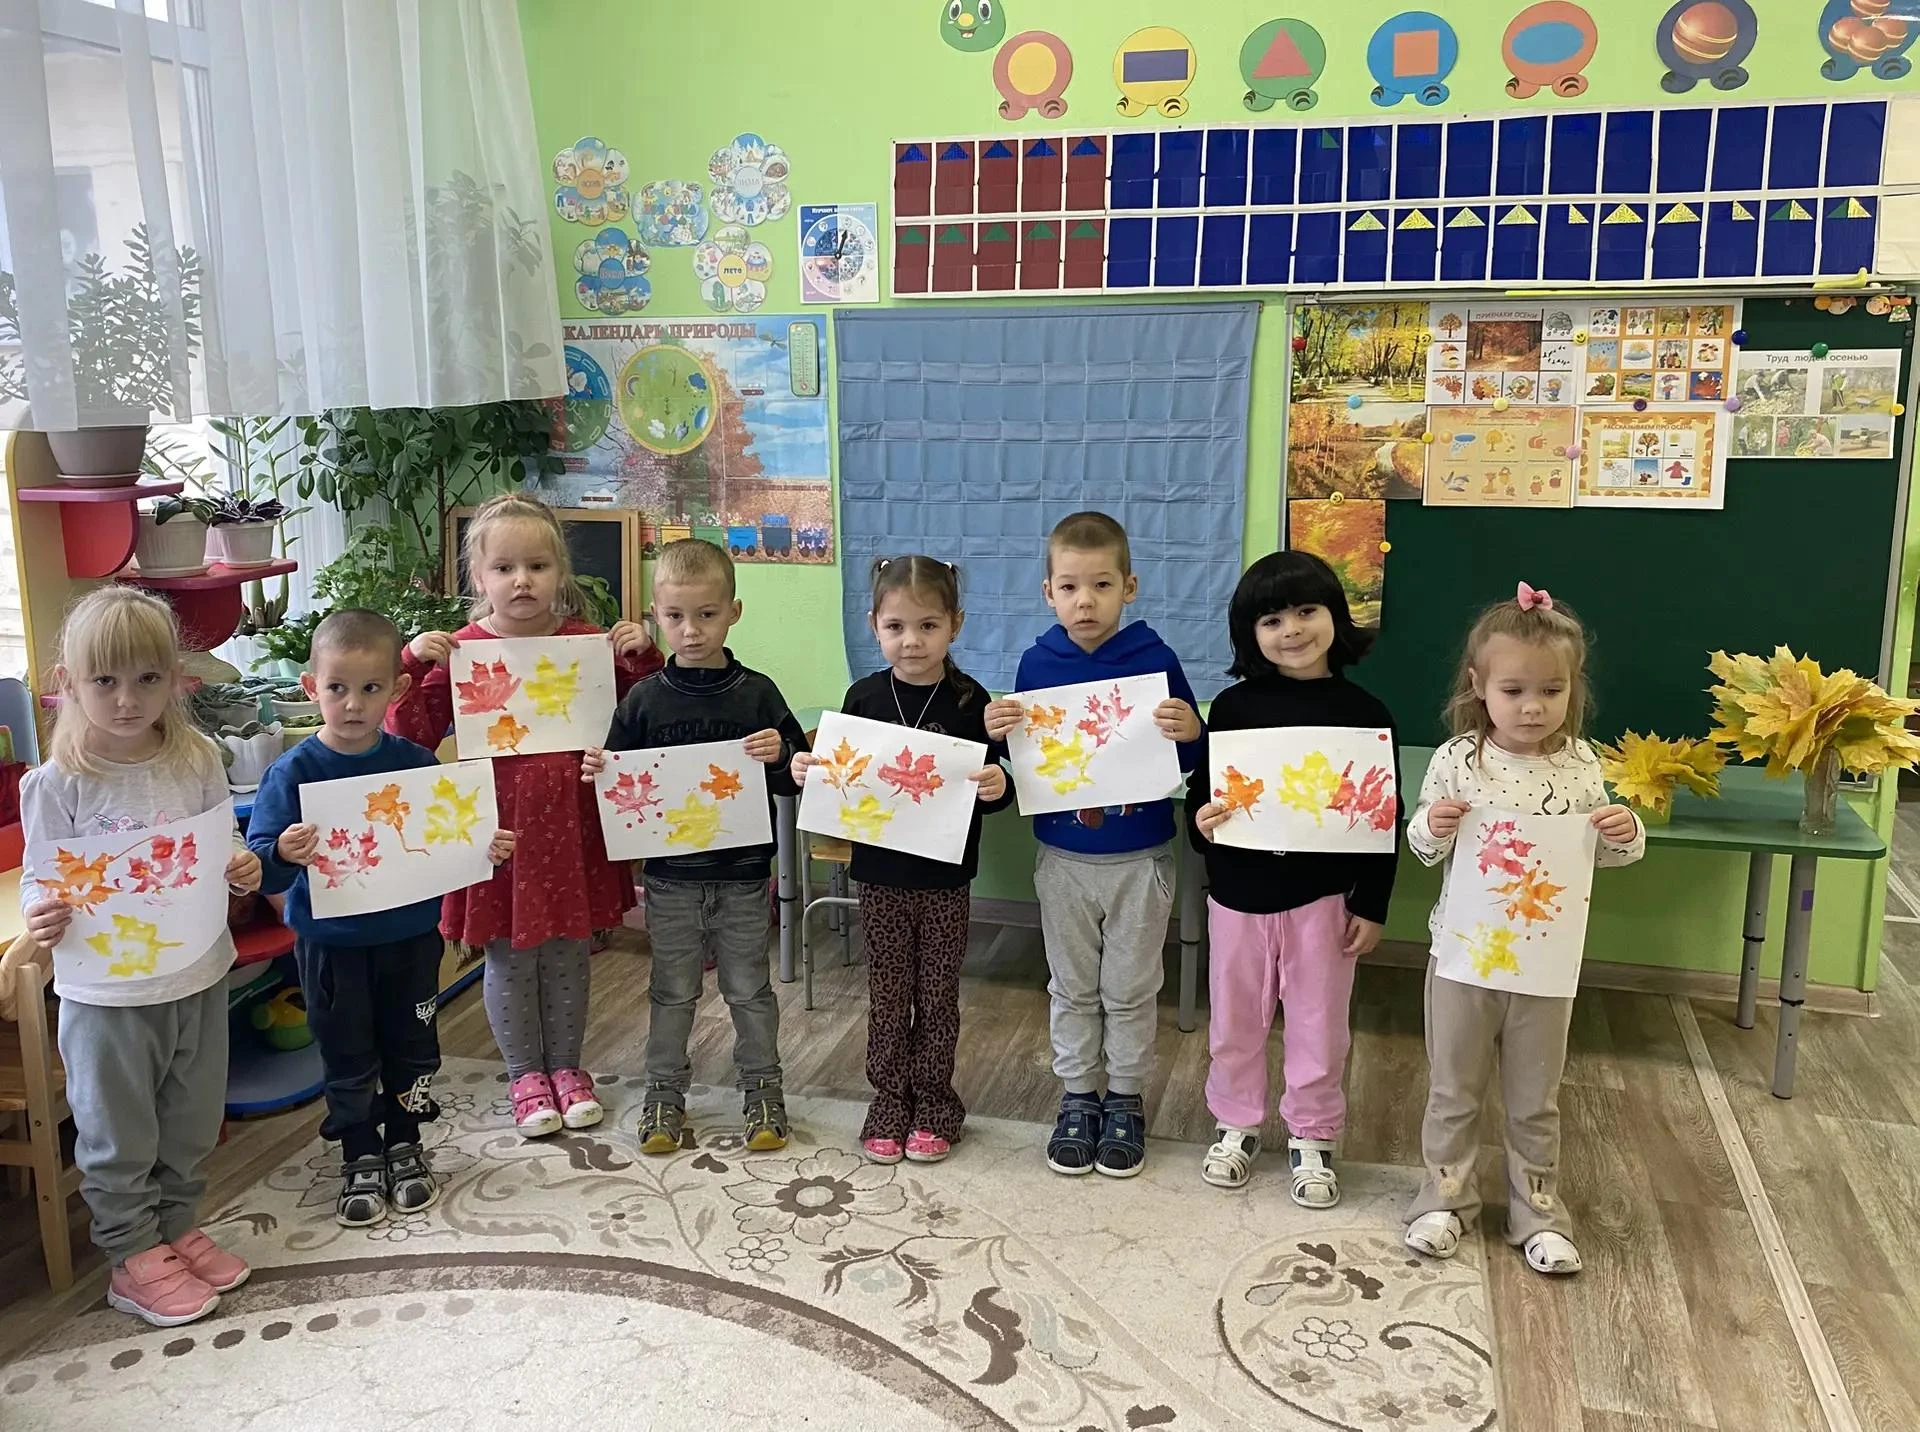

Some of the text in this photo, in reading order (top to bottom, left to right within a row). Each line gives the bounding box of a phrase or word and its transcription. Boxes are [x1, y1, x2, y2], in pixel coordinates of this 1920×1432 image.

[1475, 311, 1538, 319] ПРИЗНАКИ ОСЕНИ
[563, 323, 757, 342] КАЛЕНДАРЬ ПРИРОДЫ
[1766, 354, 1789, 363] Труд
